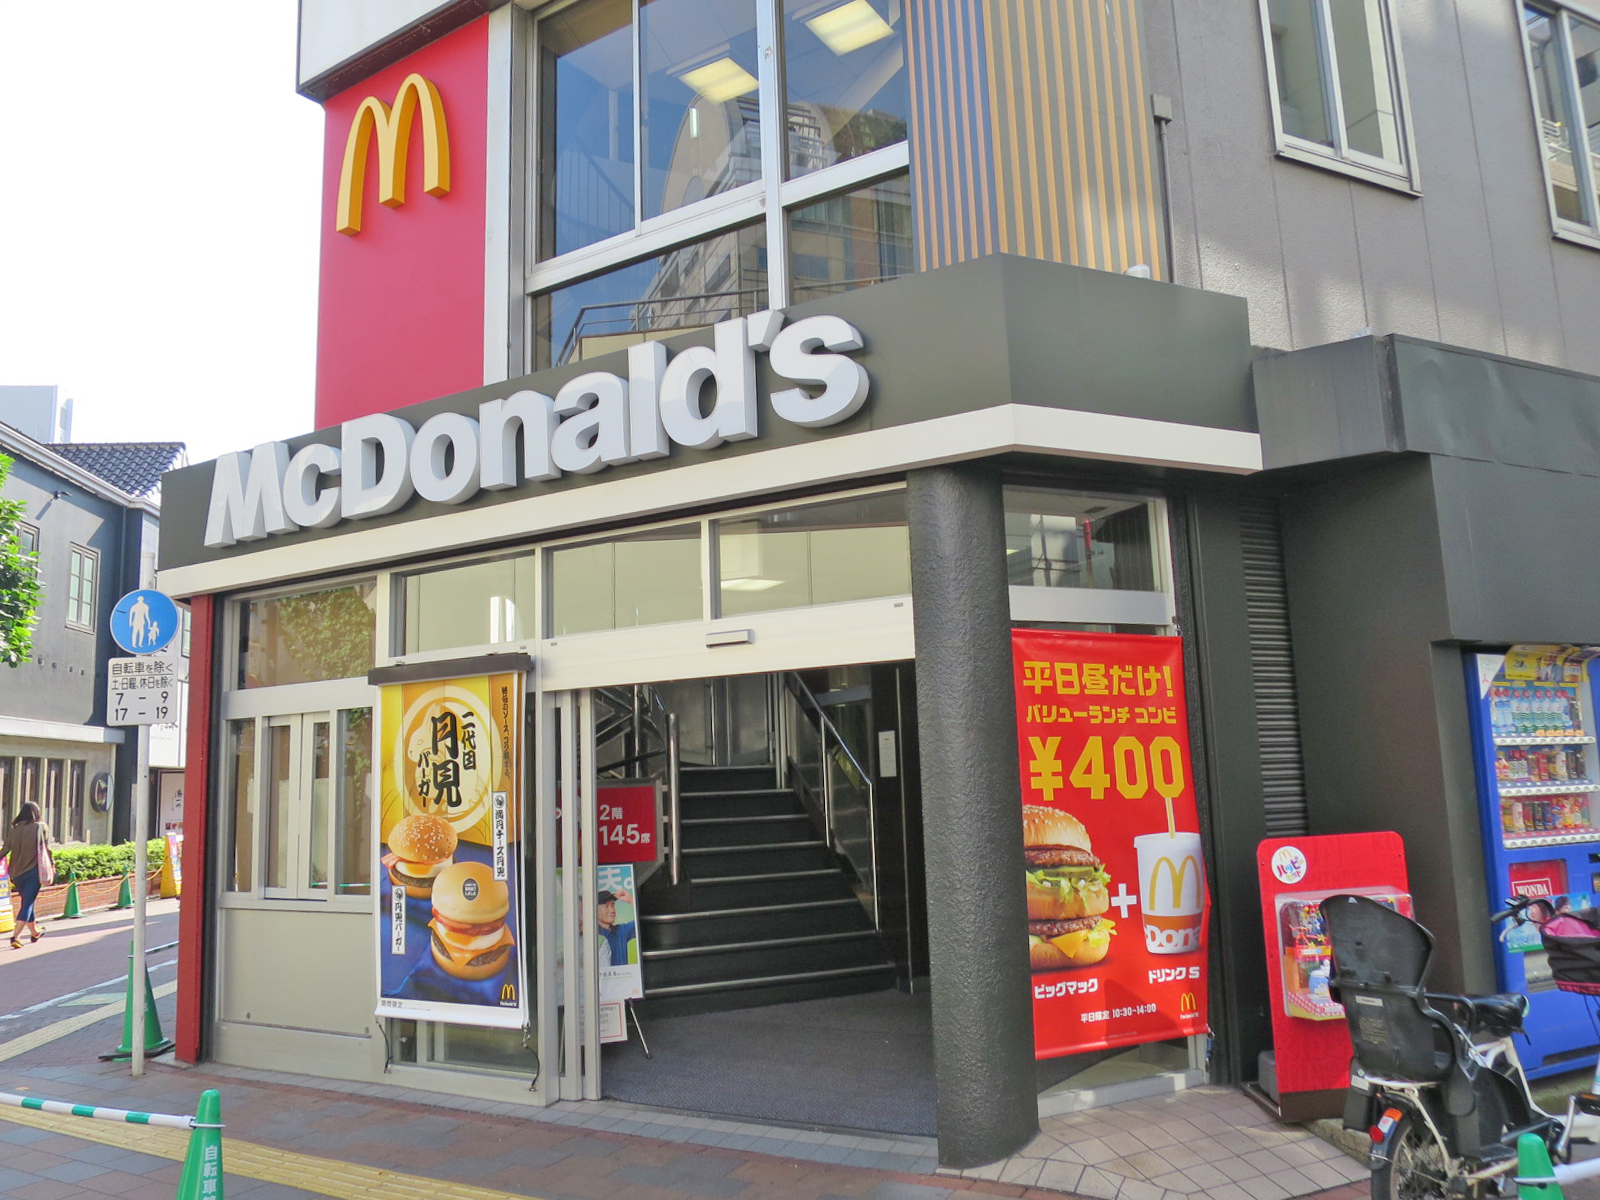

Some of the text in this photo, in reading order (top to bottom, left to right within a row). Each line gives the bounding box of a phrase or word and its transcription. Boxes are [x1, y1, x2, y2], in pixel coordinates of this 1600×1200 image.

[204, 309, 869, 548] McDonald's
[112, 661, 174, 674] 自転車を除く
[1022, 661, 1174, 698] 平日昼だけ!
[115, 693, 124, 706] 7
[161, 691, 169, 704] 9
[114, 708, 128, 721] 17
[156, 706, 169, 720] 19
[1026, 704, 1177, 724] バリューランチ コンビ
[461, 711, 477, 770] 二代目
[430, 711, 462, 808] 月見
[1027, 735, 1185, 801] ¥400
[417, 750, 432, 808] バーガー
[599, 804, 623, 820] 2階
[599, 823, 651, 846] 145席
[1516, 884, 1549, 897] WONDA
[1148, 966, 1200, 984] ドリンク S
[1034, 978, 1099, 999] ビッグマック
[1080, 1012, 1110, 1023] 平日限定
[203, 1145, 217, 1200] 自転車
